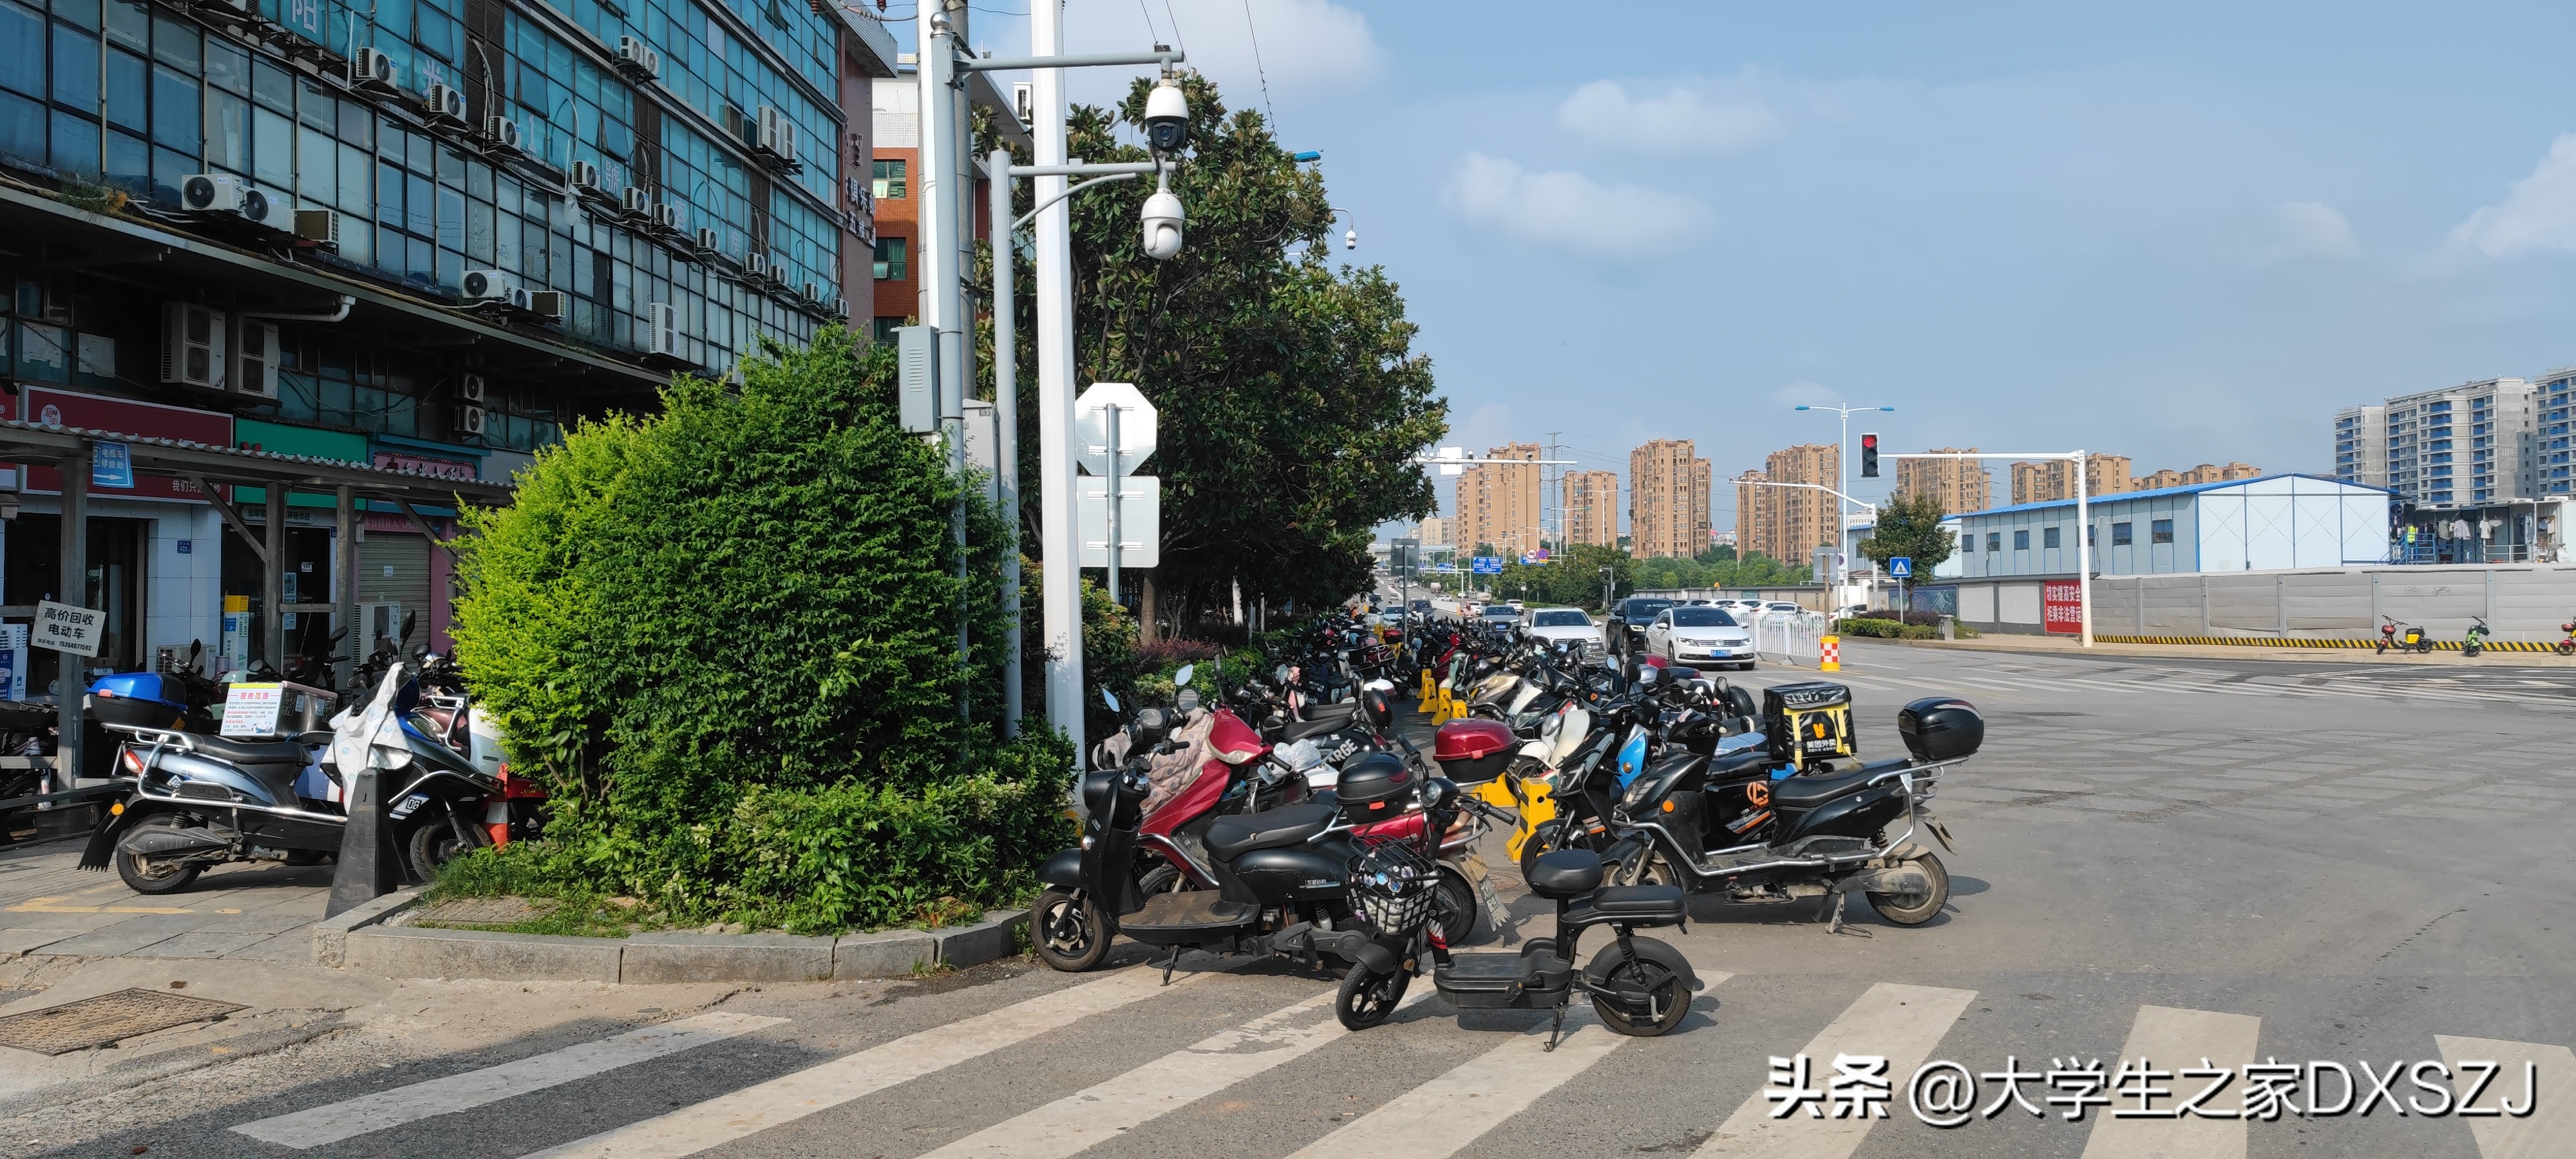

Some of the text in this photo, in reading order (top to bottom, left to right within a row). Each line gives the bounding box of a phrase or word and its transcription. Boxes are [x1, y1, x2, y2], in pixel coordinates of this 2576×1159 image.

[845, 173, 876, 218] 俱乐部
[44, 608, 95, 626] 高价回收
[48, 623, 85, 639] 电动车
[1806, 739, 1837, 749] 美团外卖
